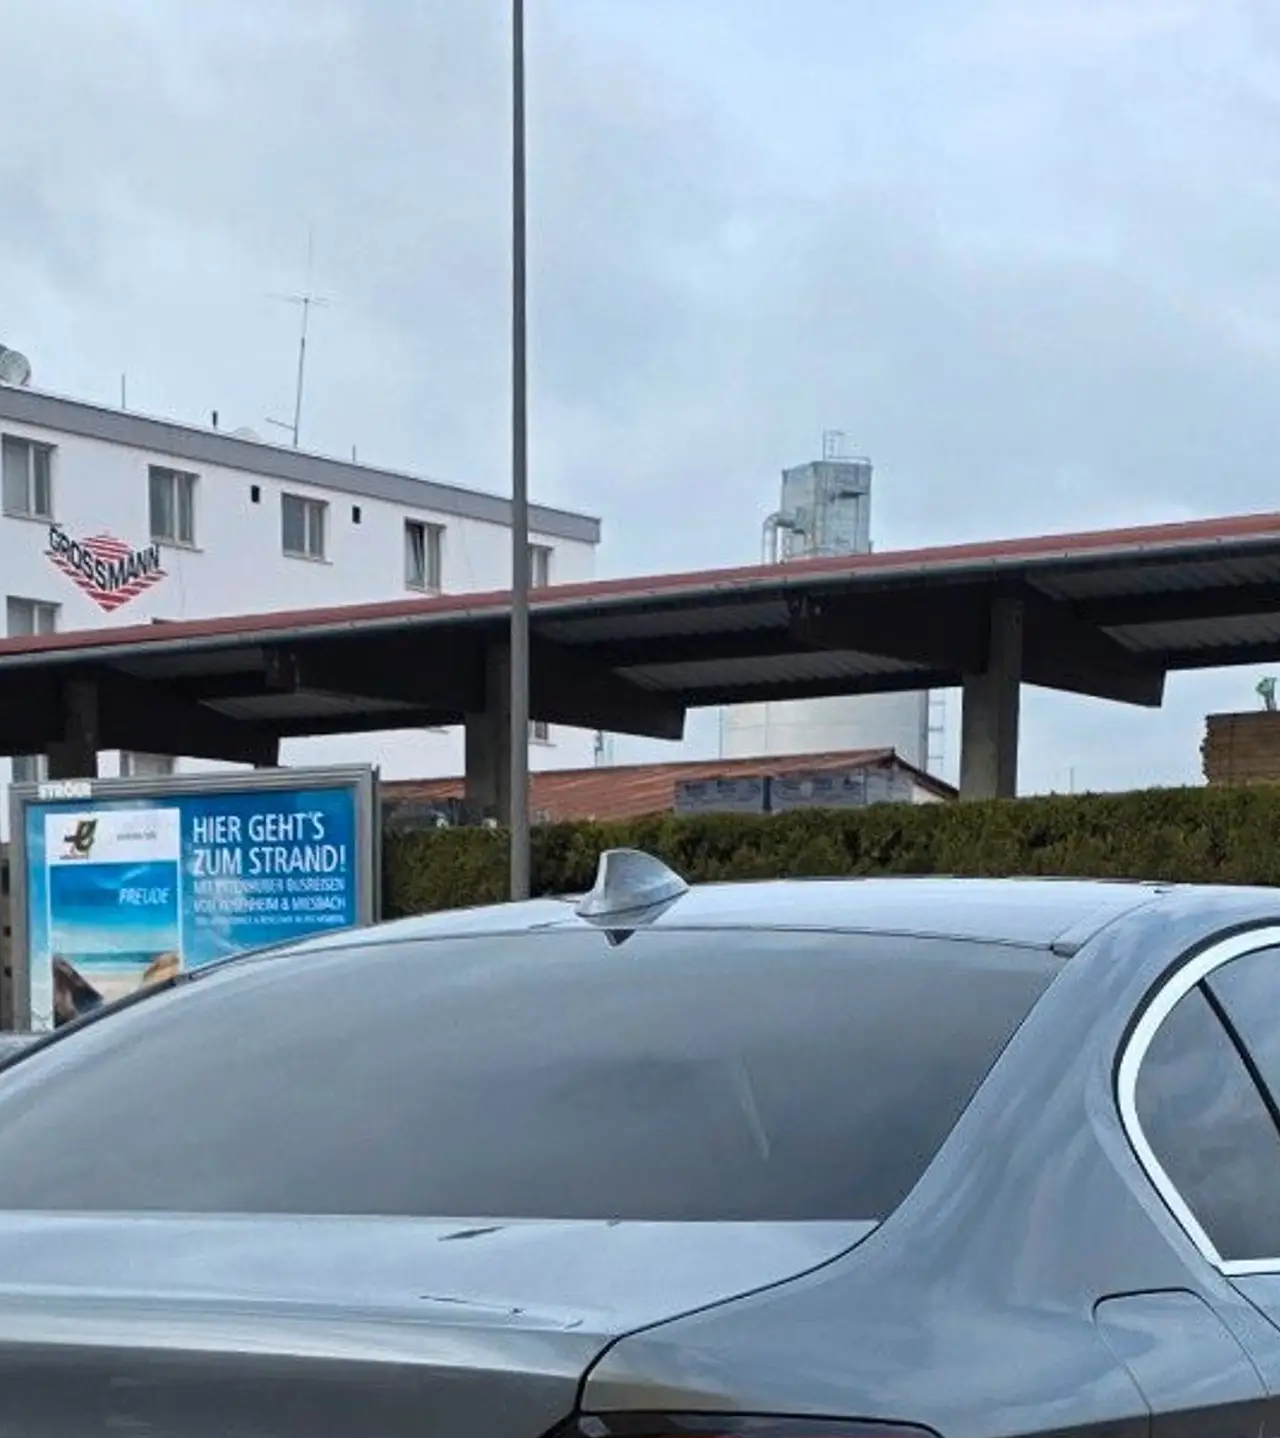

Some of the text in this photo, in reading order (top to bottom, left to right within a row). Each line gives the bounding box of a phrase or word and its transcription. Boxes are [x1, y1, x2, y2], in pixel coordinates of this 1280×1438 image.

[49, 526, 160, 591] GROSSMANN
[193, 811, 325, 843] HIER GEHT'S
[192, 844, 347, 876] ZUM STRAND!
